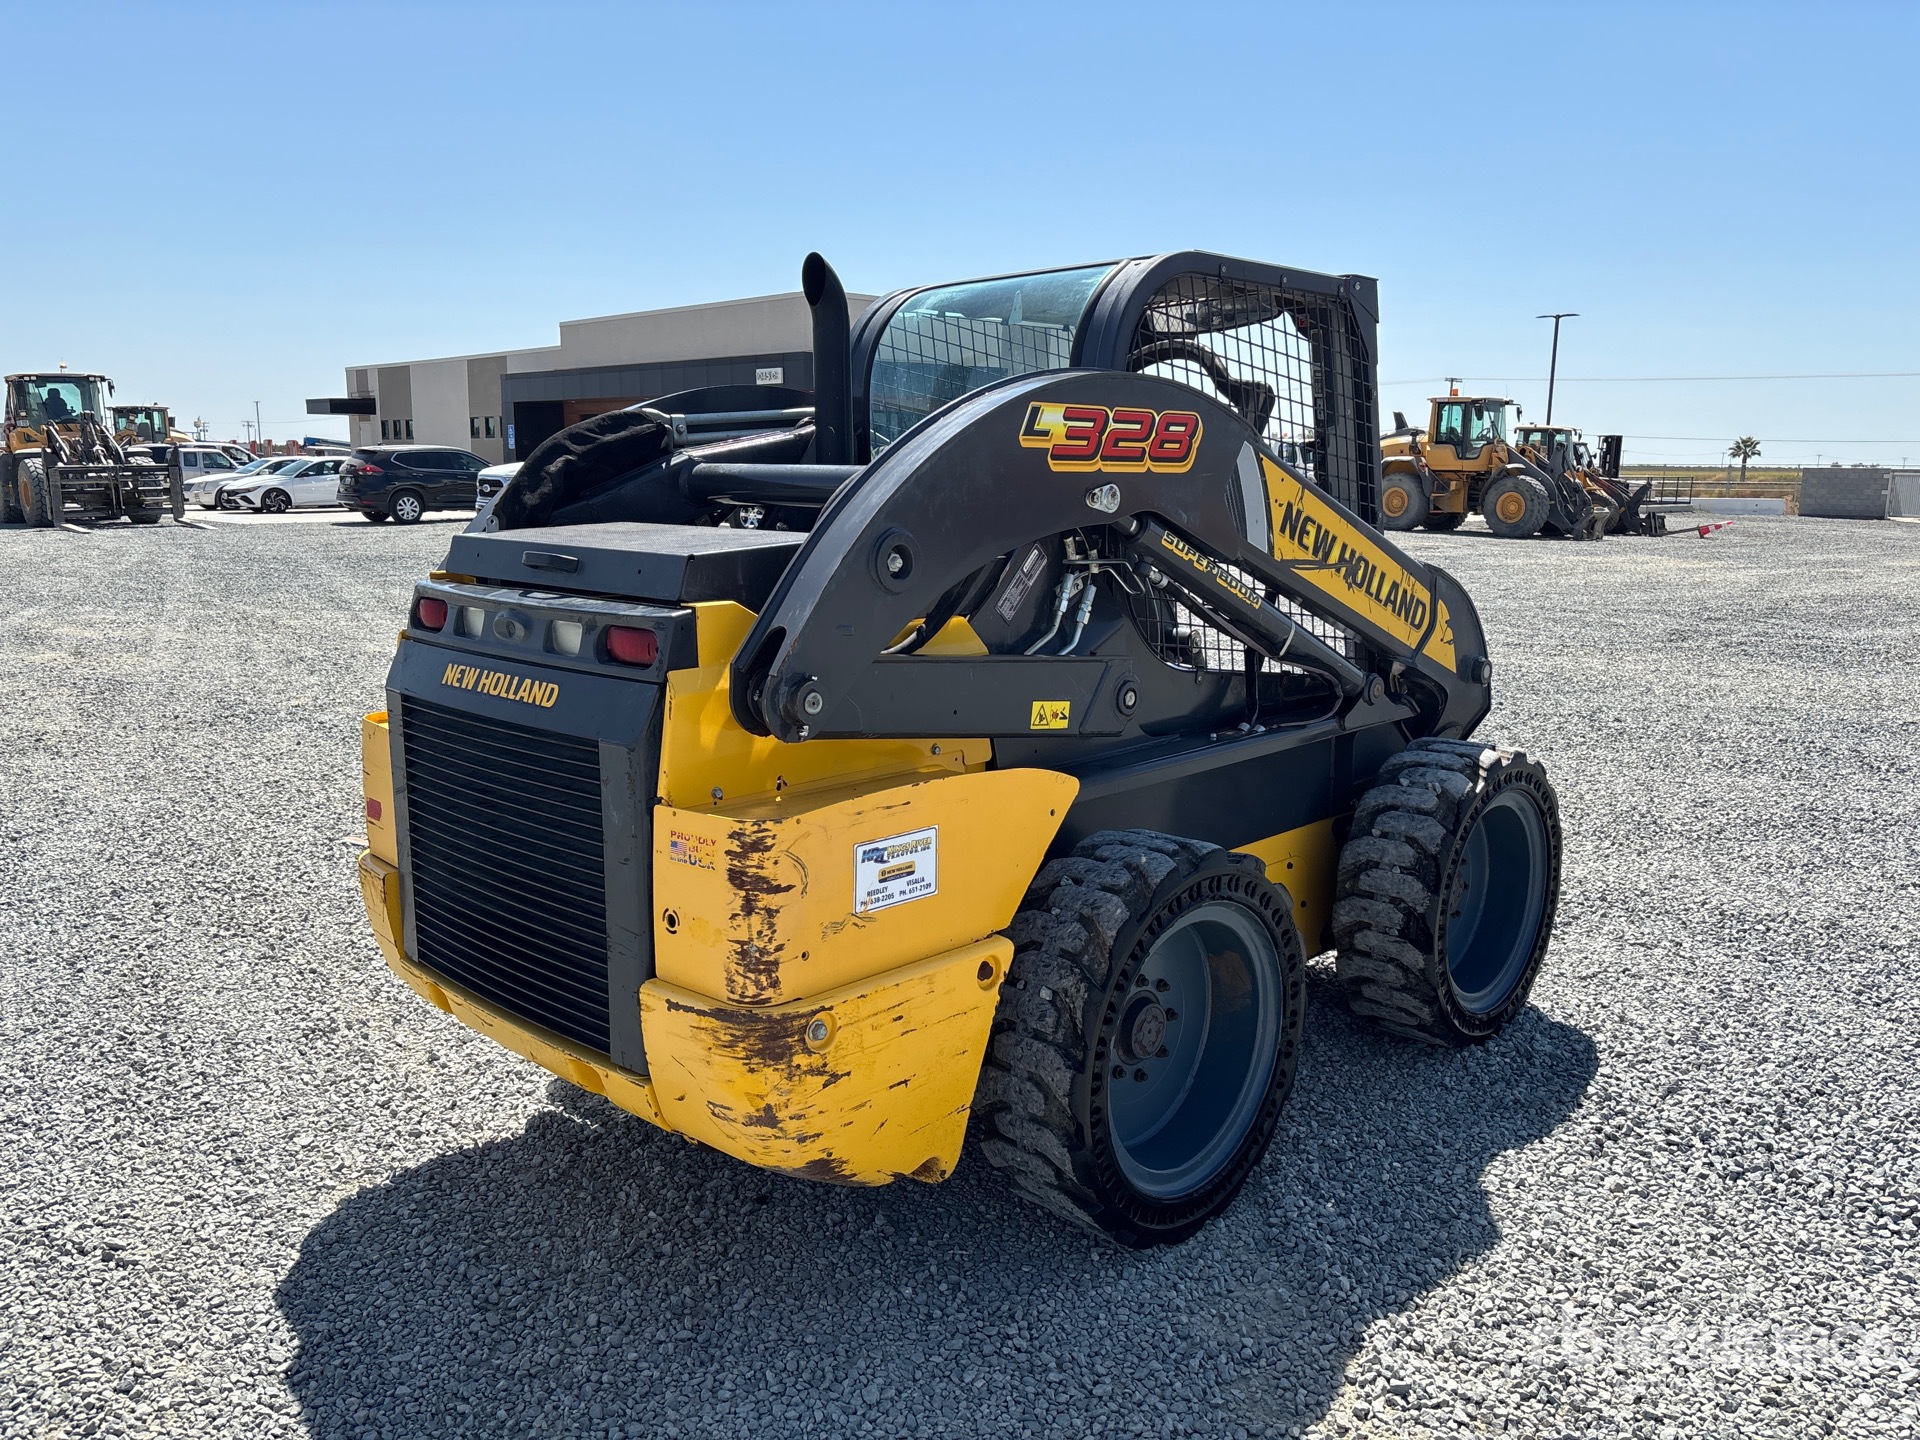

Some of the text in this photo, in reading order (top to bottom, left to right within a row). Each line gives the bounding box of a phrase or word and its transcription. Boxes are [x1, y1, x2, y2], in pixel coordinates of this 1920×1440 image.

[1019, 402, 1203, 472] L328
[1162, 531, 1261, 609] SUPER BOOM
[1279, 501, 1427, 631] NEW HOLLAND
[441, 663, 559, 708] NEW HOLLAND
[670, 830, 717, 846] PRODLY
[887, 837, 932, 855] KINGS RIVER
[906, 876, 925, 887] VISALIA
[909, 882, 932, 895] 651-2109
[867, 886, 889, 897] REEDLEY
